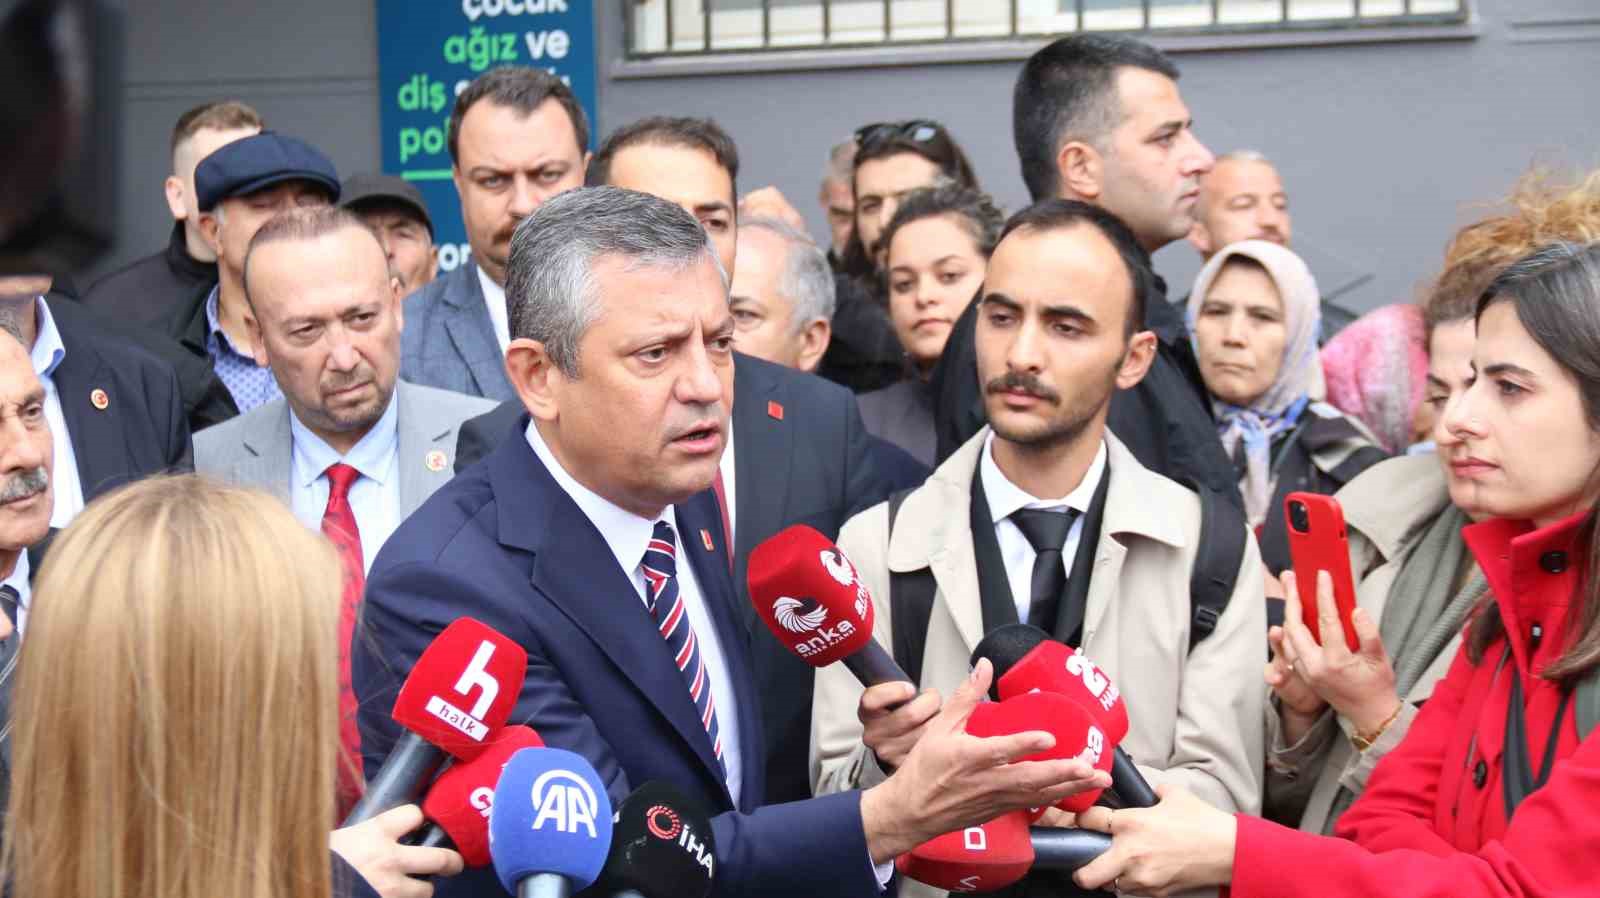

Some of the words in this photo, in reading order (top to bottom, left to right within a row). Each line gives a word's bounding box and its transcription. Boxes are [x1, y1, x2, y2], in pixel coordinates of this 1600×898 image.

[443, 26, 518, 71] ağız
[525, 29, 570, 59] ve
[398, 74, 446, 112] diş
[795, 620, 853, 654] anka
[439, 704, 477, 734] halk
[531, 784, 598, 838] AA
[679, 824, 713, 879] İHA
